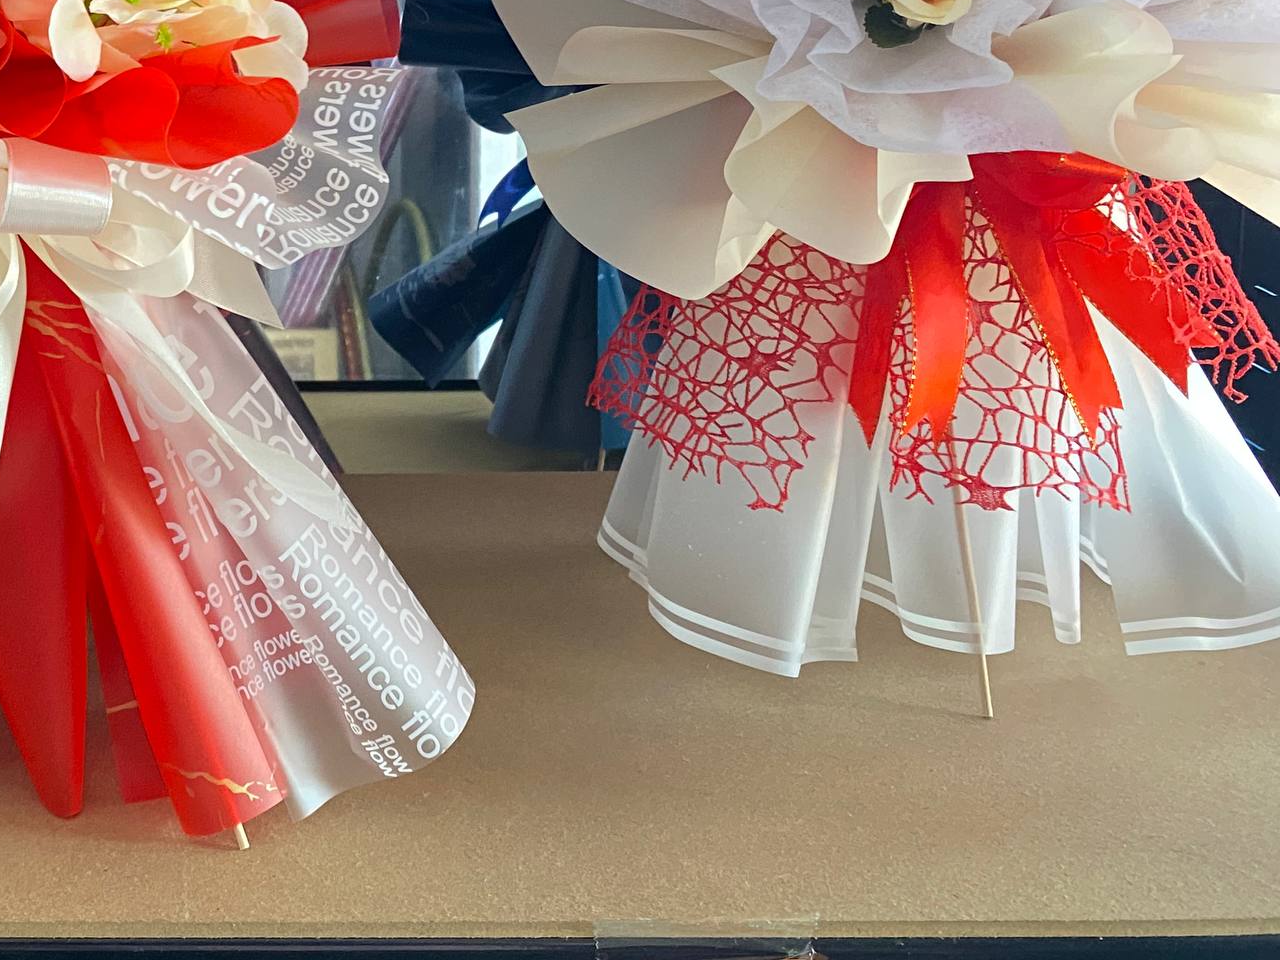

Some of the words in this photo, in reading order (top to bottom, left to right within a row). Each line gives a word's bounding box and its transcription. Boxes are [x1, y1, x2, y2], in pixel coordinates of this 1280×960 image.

[278, 539, 406, 711] Romance
[295, 522, 424, 691] Romance
[253, 628, 302, 662] flowe
[262, 647, 313, 683] flowe
[360, 738, 399, 779] flow
[376, 733, 414, 774] flow
